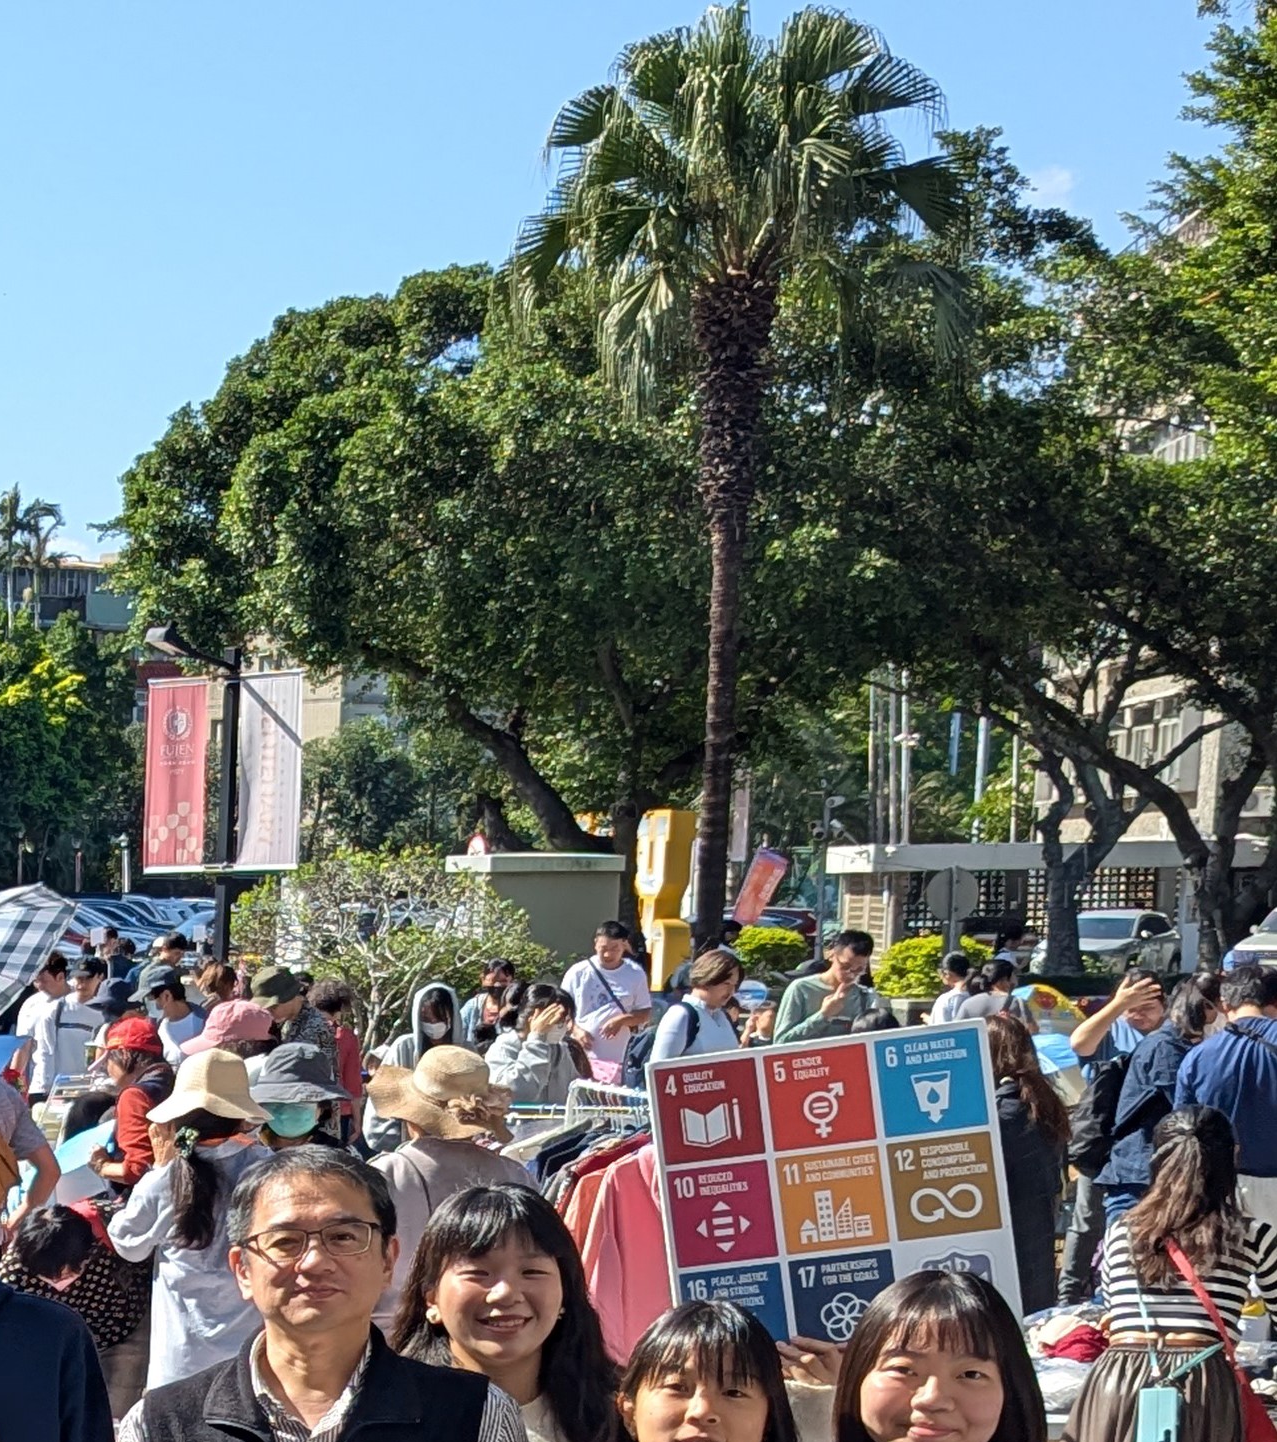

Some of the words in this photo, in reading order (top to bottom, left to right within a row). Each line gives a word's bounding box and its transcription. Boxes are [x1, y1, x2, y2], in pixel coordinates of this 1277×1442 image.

[904, 1041, 928, 1054] CLEAN
[930, 1038, 956, 1050] WATER
[792, 1056, 822, 1068] GENDER
[885, 1046, 898, 1068] 6
[905, 1054, 922, 1065] AND
[923, 1048, 967, 1063] SANITATION
[683, 1070, 713, 1083] QUALITY
[773, 1061, 786, 1082] 5
[793, 1066, 830, 1080] EQUALITY
[665, 1075, 677, 1096] 4
[684, 1080, 726, 1094] EDUCATION
[920, 1142, 969, 1156] RESPONSIBLE
[803, 1157, 851, 1172] SUSTAINABLE
[851, 1154, 875, 1166] CITIES
[895, 1149, 915, 1172] 12
[921, 1154, 976, 1168] CONSUMPTION
[699, 1172, 733, 1184] REDUCED
[783, 1163, 800, 1185] 11
[805, 1172, 822, 1183] AND
[822, 1166, 874, 1180] COMMUNITIES
[923, 1169, 940, 1180] AND
[940, 1163, 988, 1178] PRODUCTION
[674, 1176, 694, 1199] 10
[821, 1258, 878, 1274] PARTNERSHIPS
[737, 1271, 769, 1283] JUSTICE
[798, 1266, 816, 1288] 17
[822, 1274, 836, 1285] FOR
[839, 1272, 853, 1283] THE
[854, 1270, 879, 1282] GOALS
[687, 1279, 707, 1300] 16
[729, 1284, 760, 1296] STRONG
